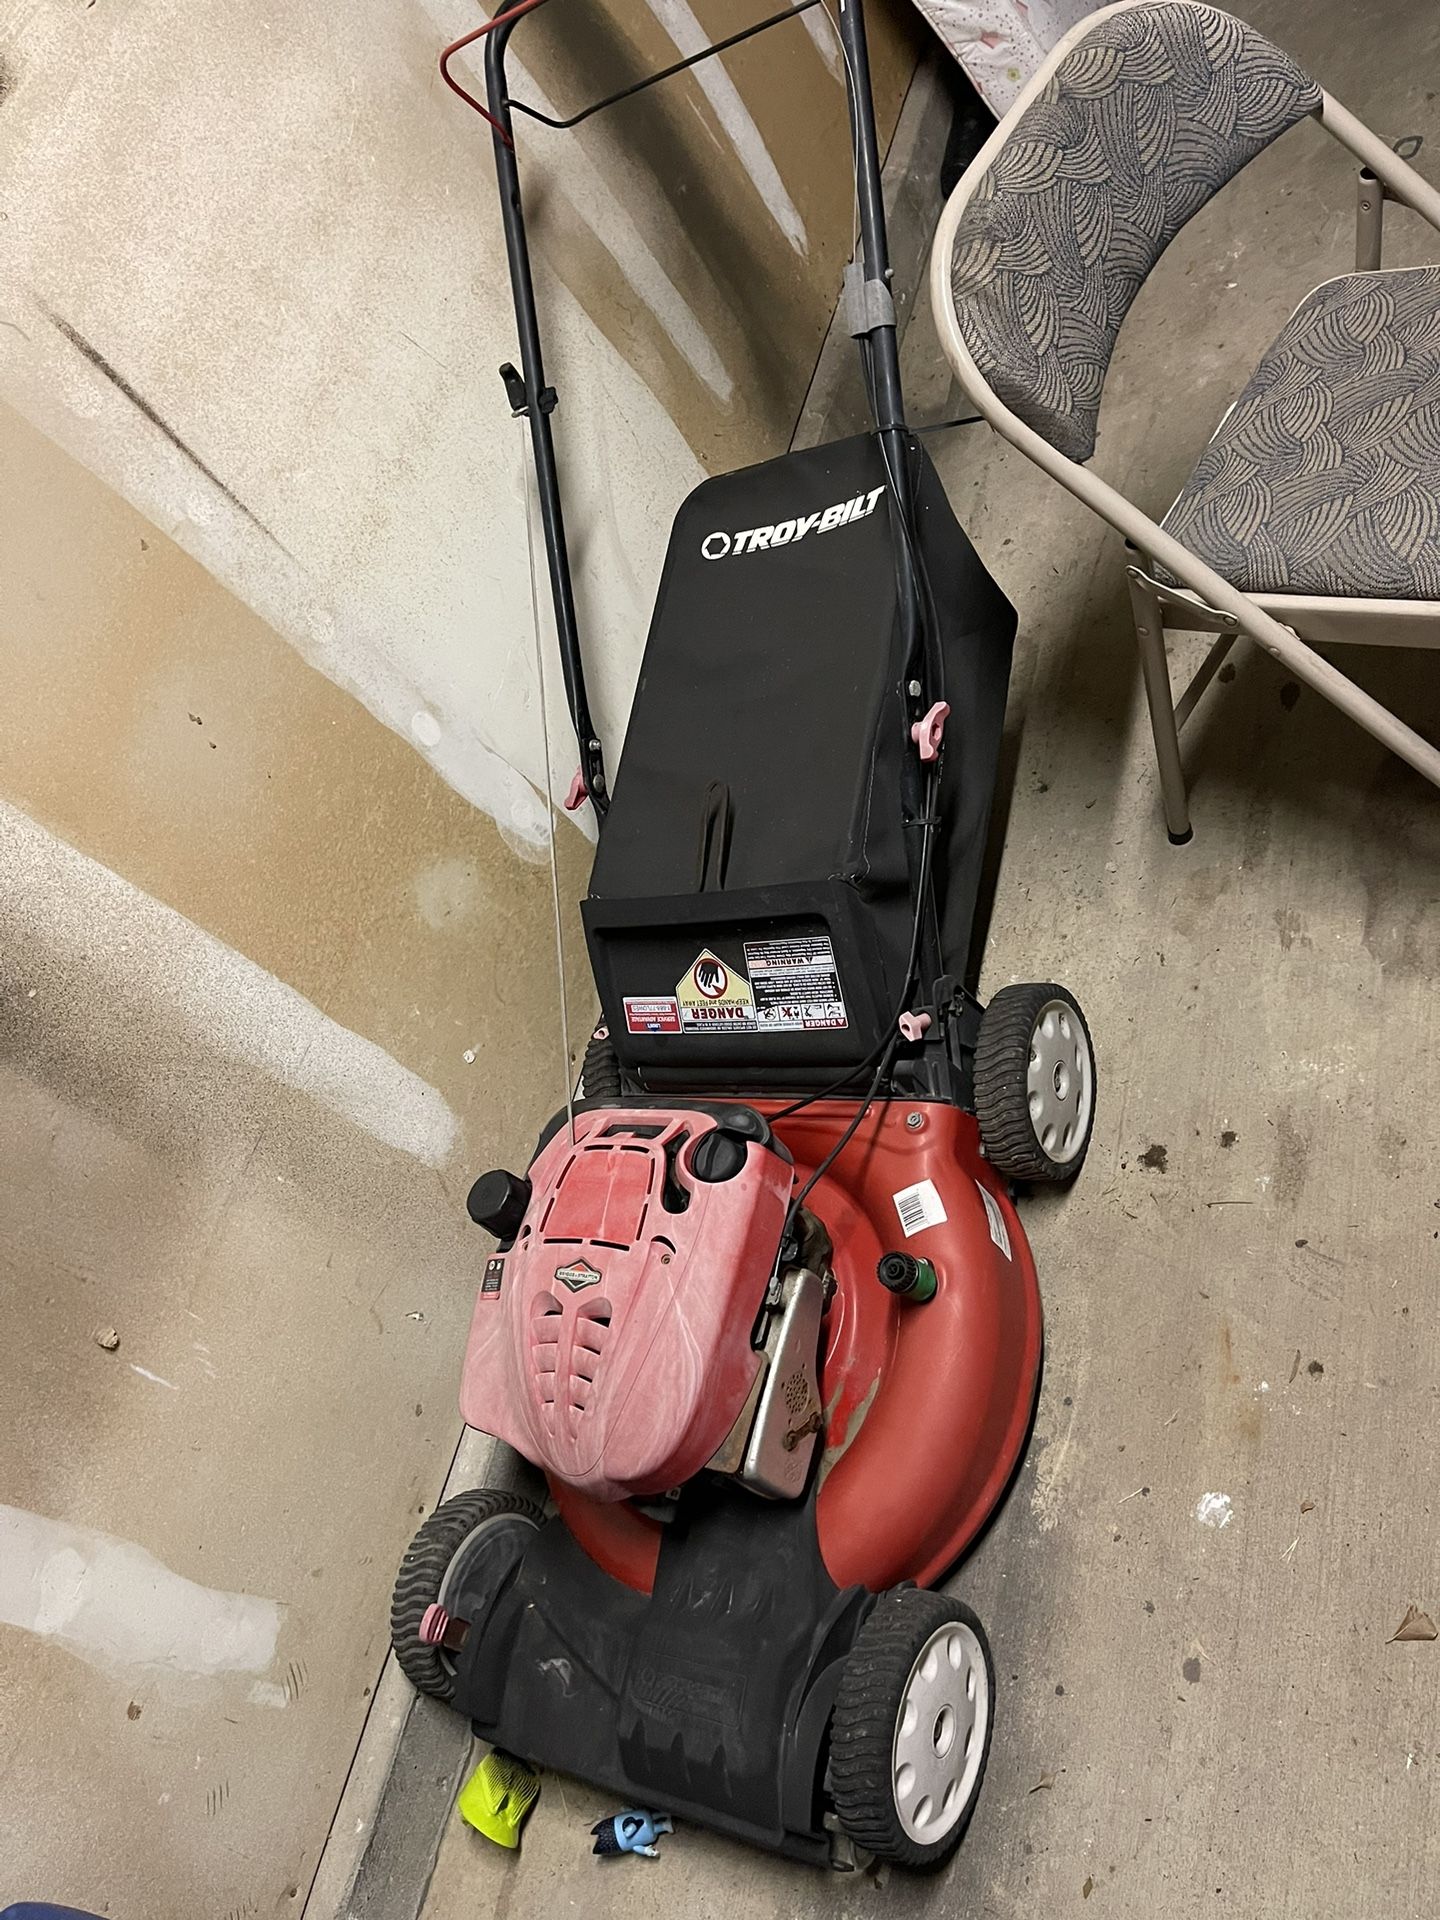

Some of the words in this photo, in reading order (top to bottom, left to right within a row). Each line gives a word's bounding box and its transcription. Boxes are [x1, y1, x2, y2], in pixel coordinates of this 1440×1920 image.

[732, 485, 886, 556] TROY-BILT
[766, 958, 804, 966] WARNING
[736, 998, 749, 1006] KEEP
[692, 1007, 744, 1019] DANGER
[805, 1019, 836, 1027] DANGER
